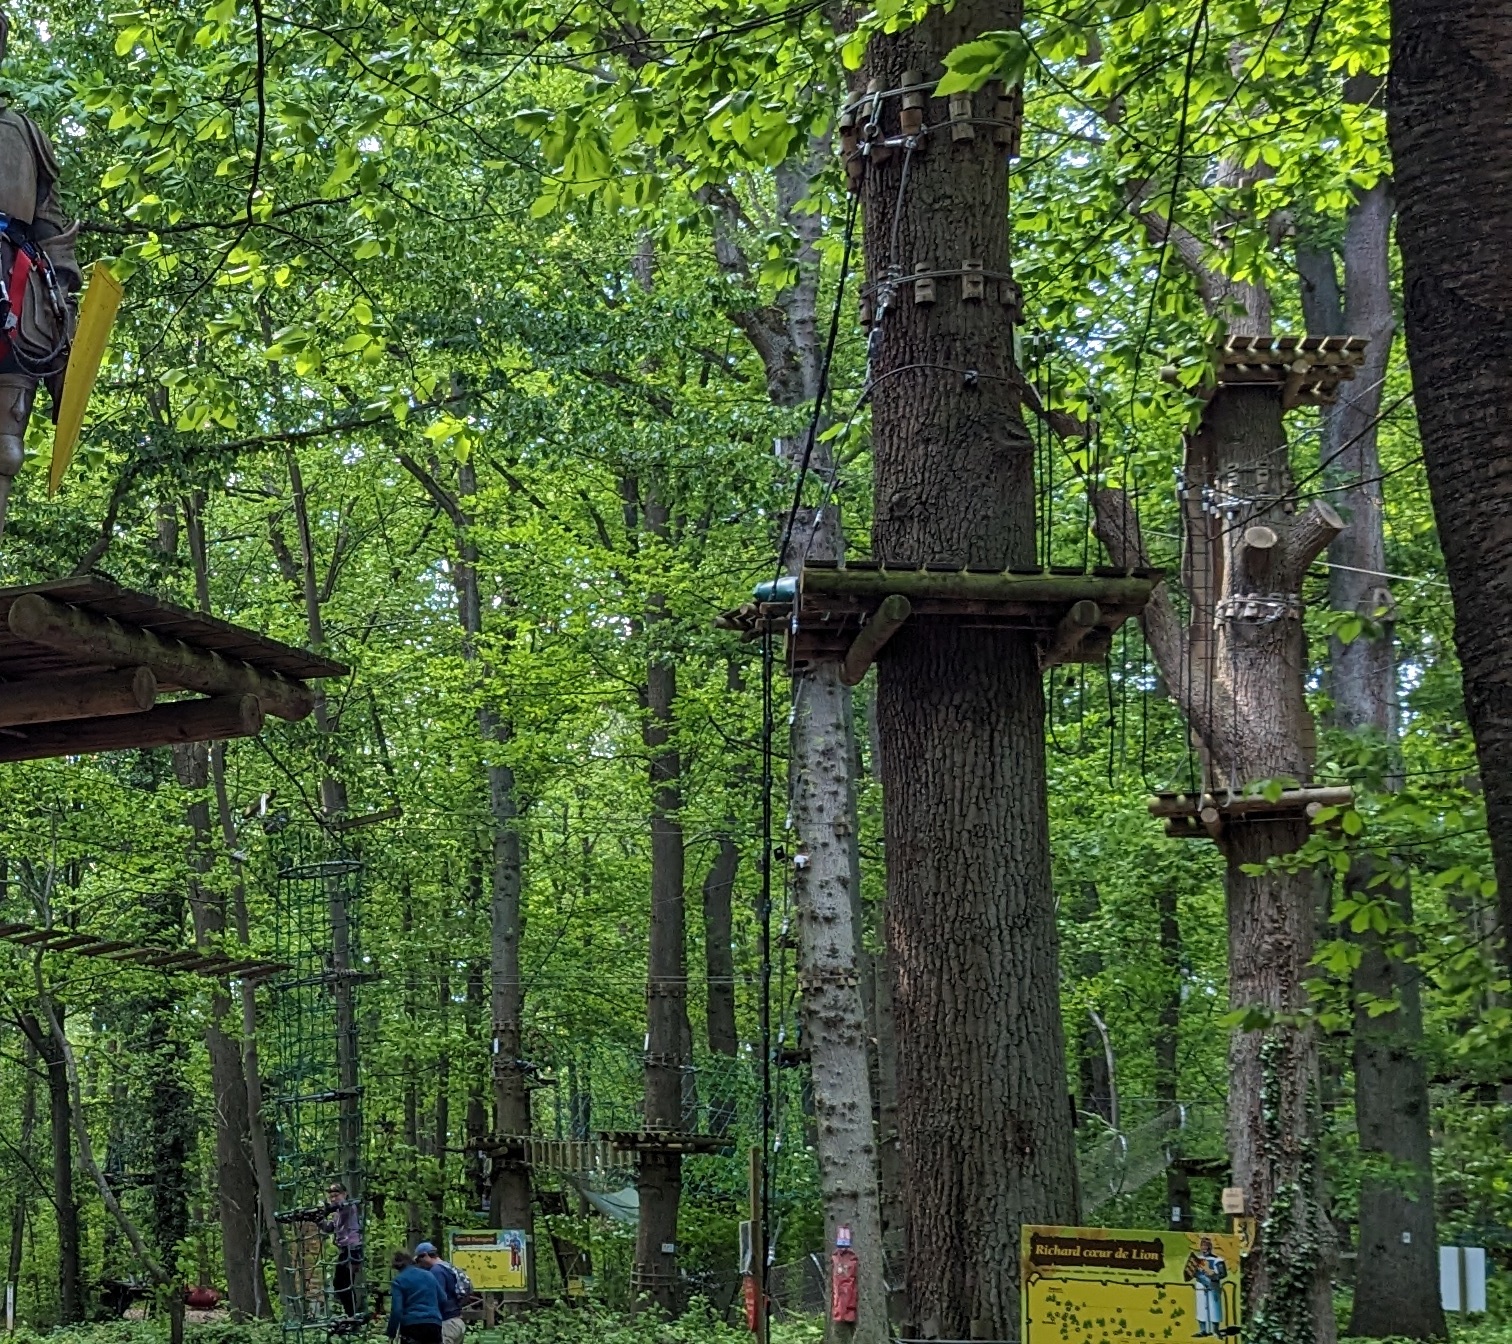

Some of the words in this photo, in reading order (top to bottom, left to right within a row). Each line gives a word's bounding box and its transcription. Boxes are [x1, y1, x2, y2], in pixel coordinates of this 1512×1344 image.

[1035, 1244, 1080, 1256] Richard
[1114, 1247, 1129, 1259] de
[1131, 1249, 1159, 1261] Lion
